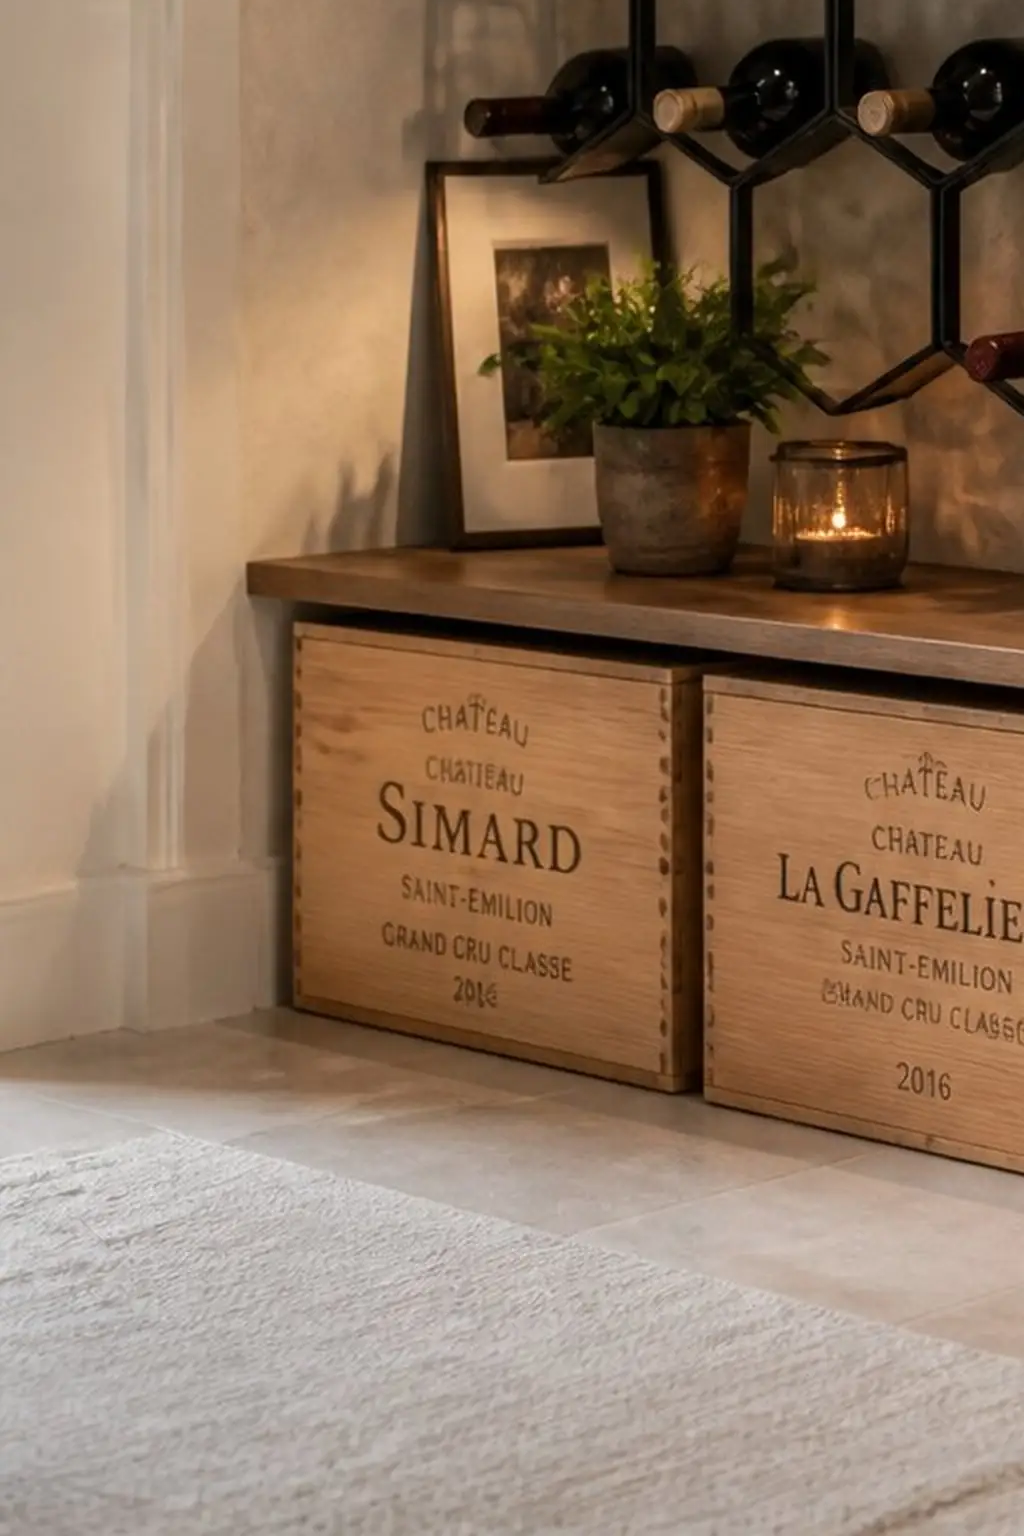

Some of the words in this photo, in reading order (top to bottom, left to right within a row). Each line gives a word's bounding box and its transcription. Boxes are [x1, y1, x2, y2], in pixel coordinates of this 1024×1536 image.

[377, 780, 582, 874] SIMARD
[871, 824, 983, 866] CHATEAU
[401, 874, 553, 927] SAINT-EMILION
[776, 852, 824, 909] LA
[382, 921, 447, 956] GRAND
[453, 935, 492, 964] CRU
[498, 945, 574, 982] CLASSE
[840, 939, 1013, 994] SAINT-EMILION
[901, 997, 941, 1024] CRU
[896, 1061, 951, 1100] 2016
